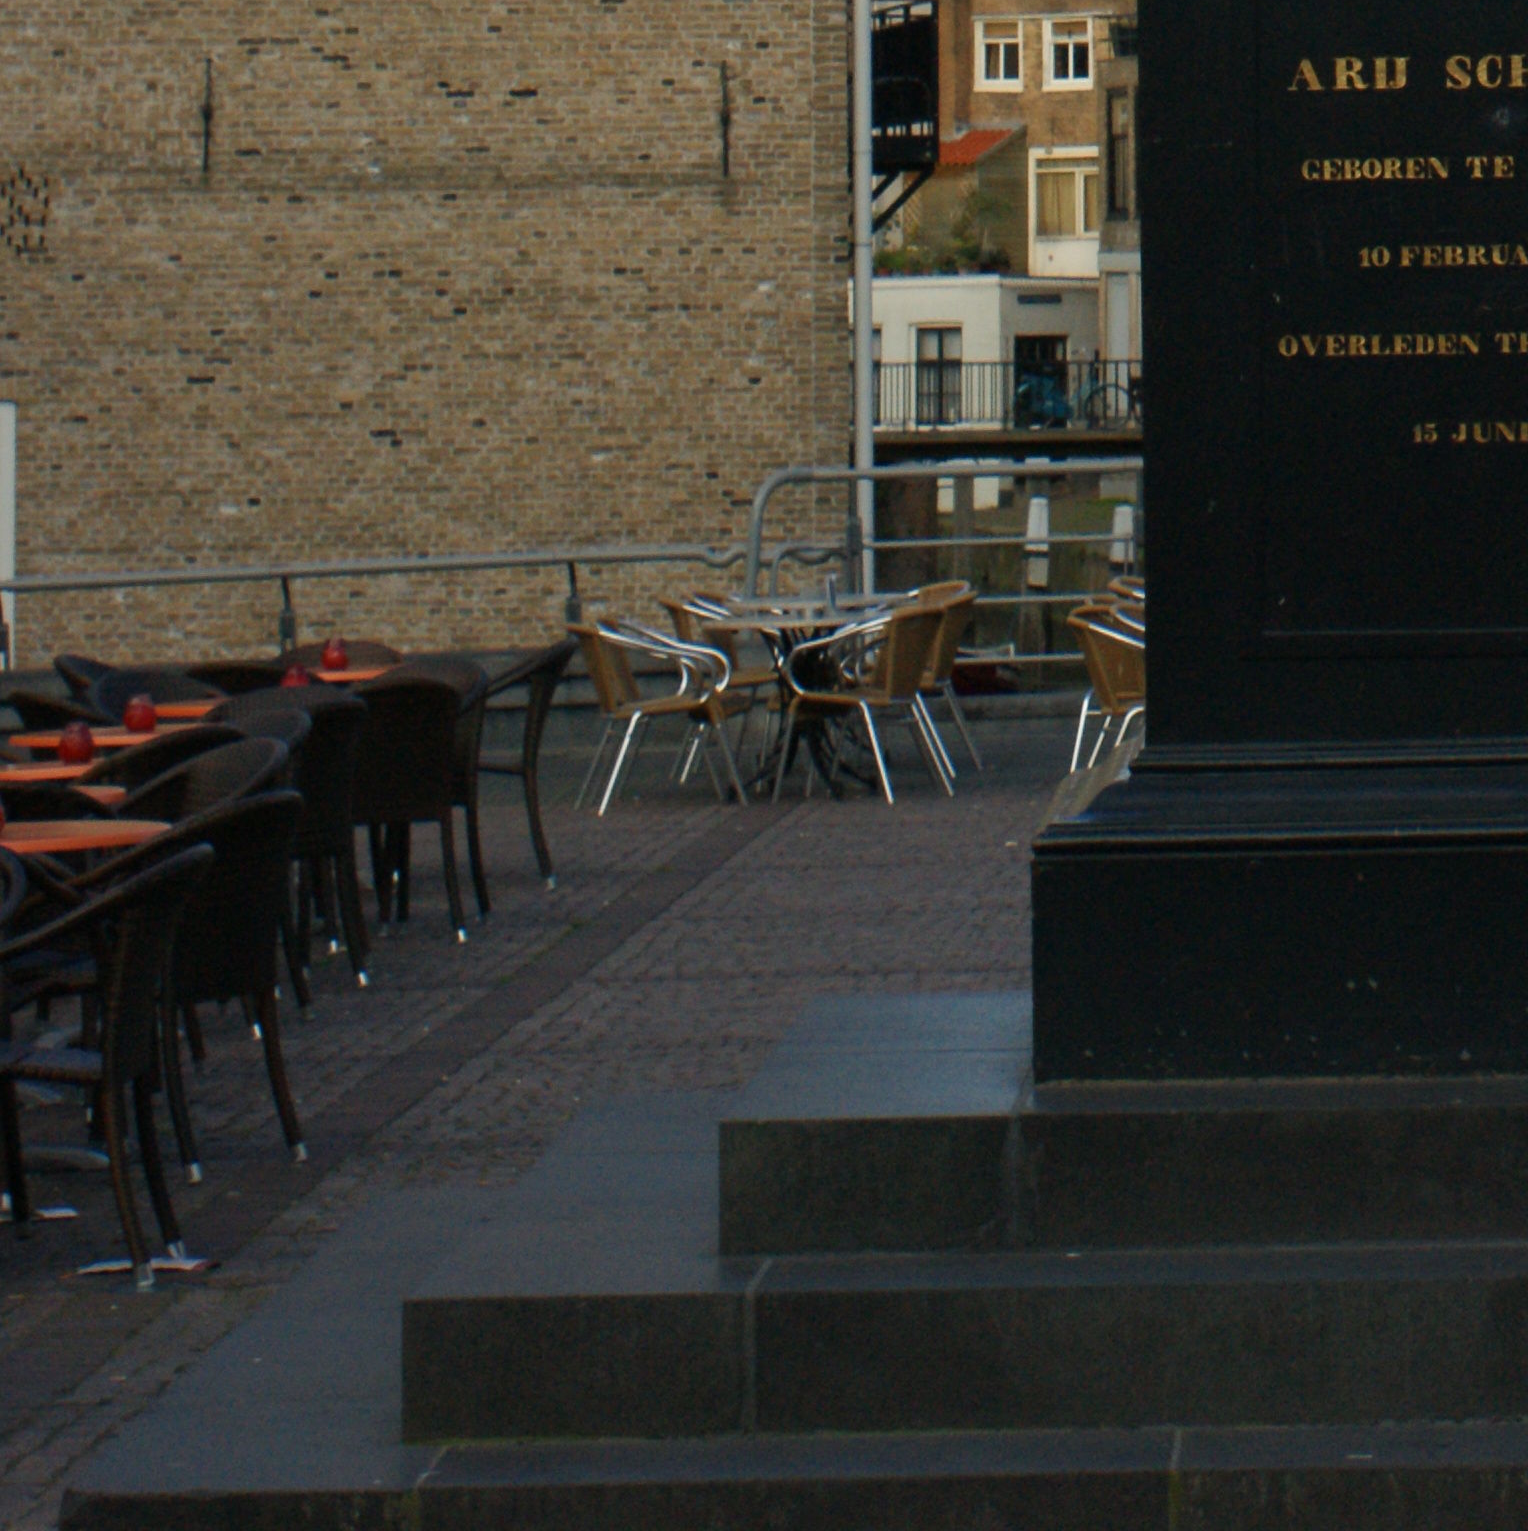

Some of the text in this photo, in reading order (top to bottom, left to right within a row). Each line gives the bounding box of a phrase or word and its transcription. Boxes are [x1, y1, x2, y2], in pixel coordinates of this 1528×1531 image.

[1287, 55, 1411, 92] ARIJ
[1300, 155, 1450, 182] GEBOREN
[1464, 154, 1514, 179] TE
[1358, 245, 1391, 268] 10
[1277, 332, 1480, 358] OVERLEDEN
[1412, 422, 1439, 443] 15
